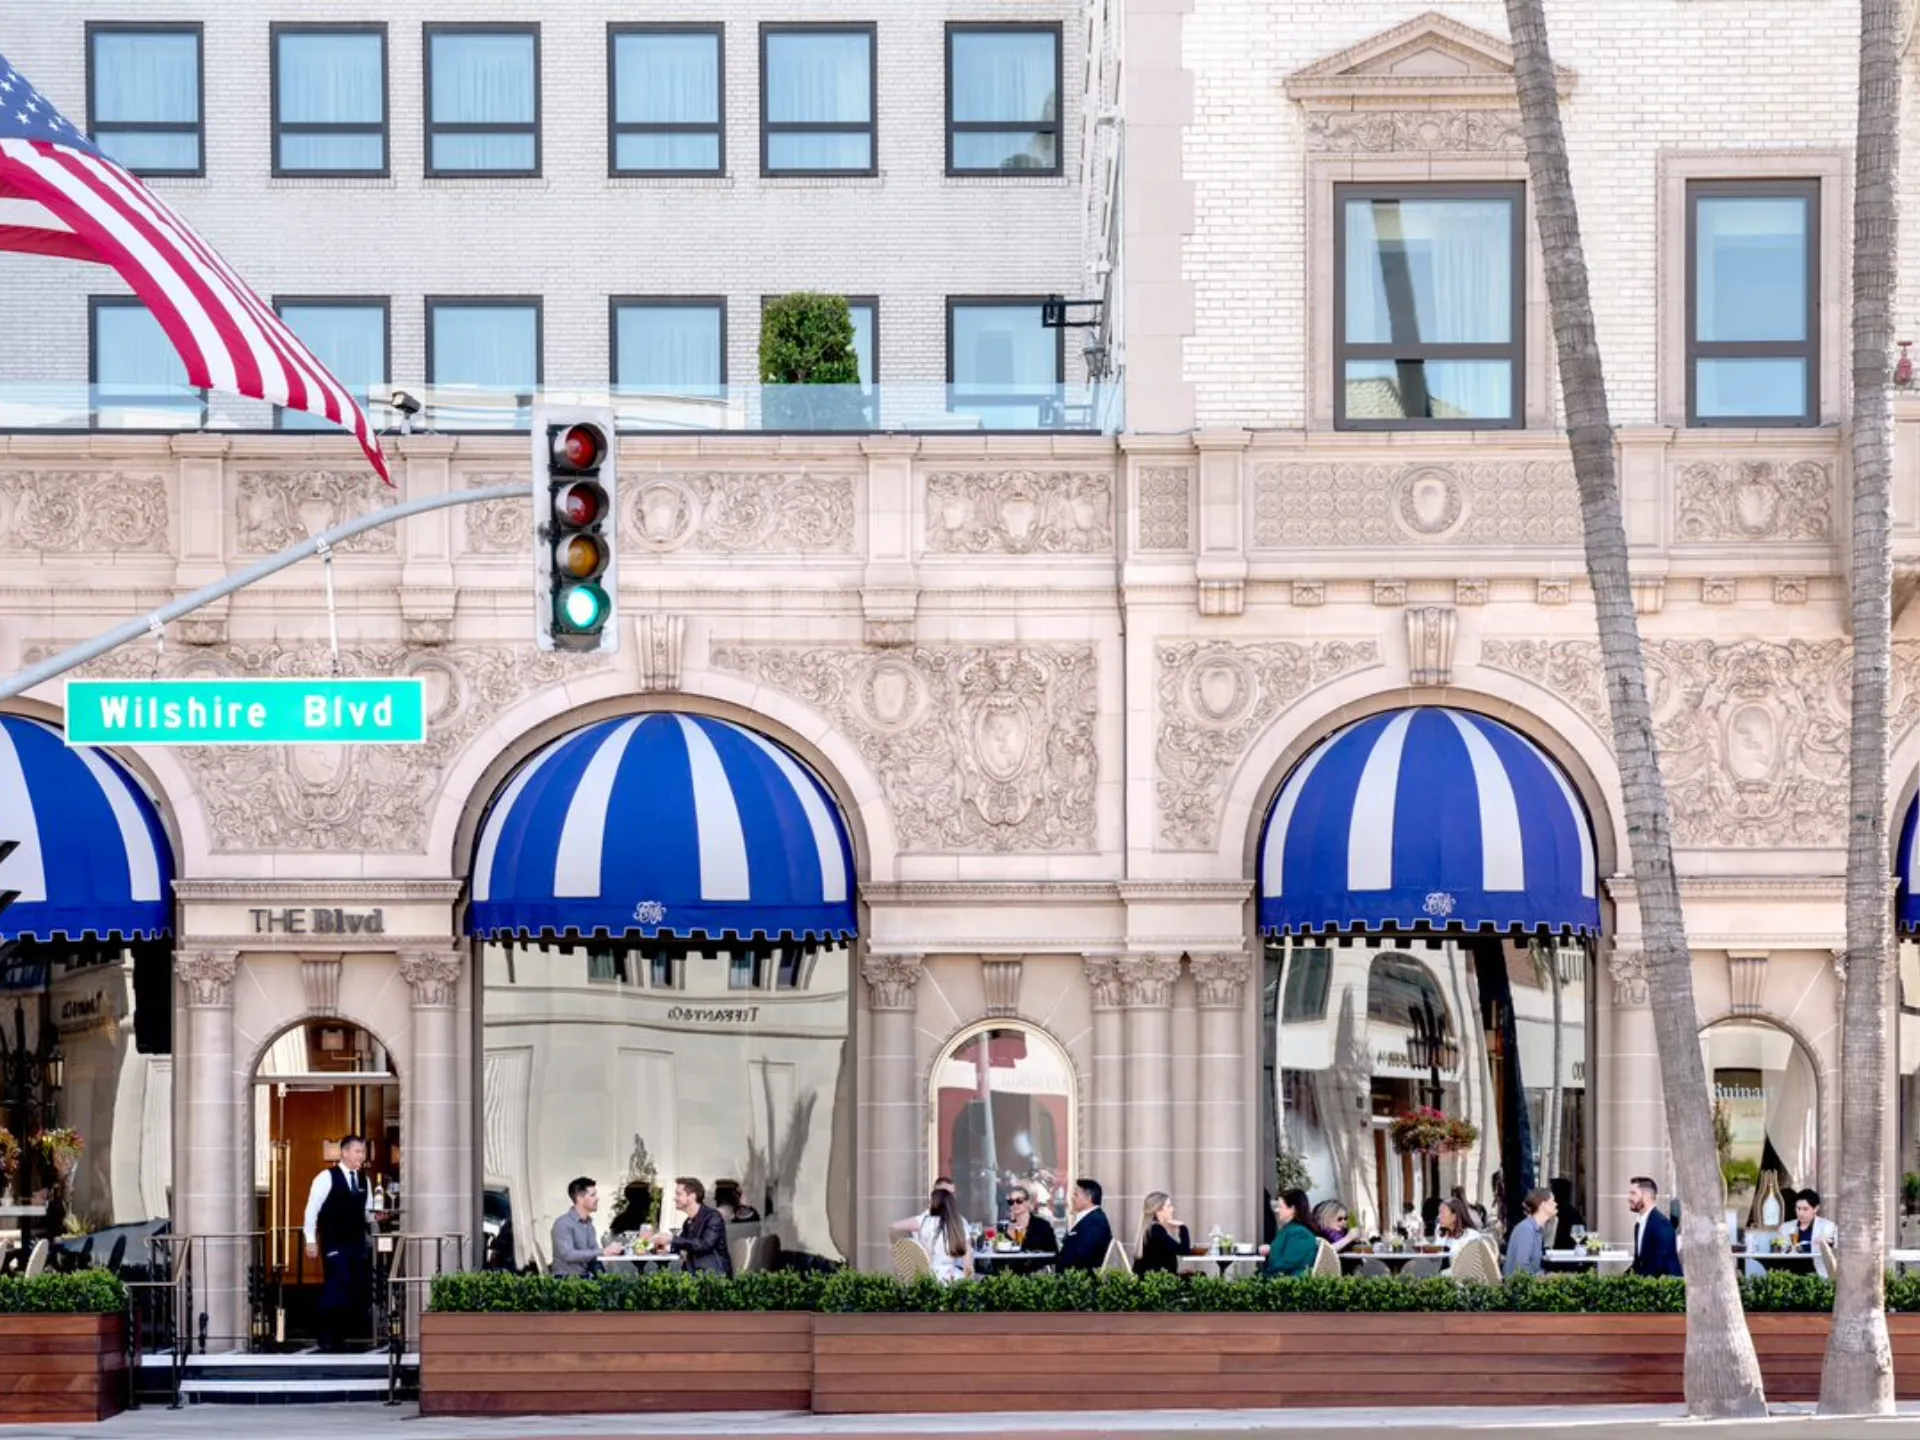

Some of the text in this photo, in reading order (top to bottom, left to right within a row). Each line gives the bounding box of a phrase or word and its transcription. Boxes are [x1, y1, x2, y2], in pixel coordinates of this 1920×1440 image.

[100, 693, 393, 729] Wilshire Blvd
[248, 908, 384, 934] THE Blvd
